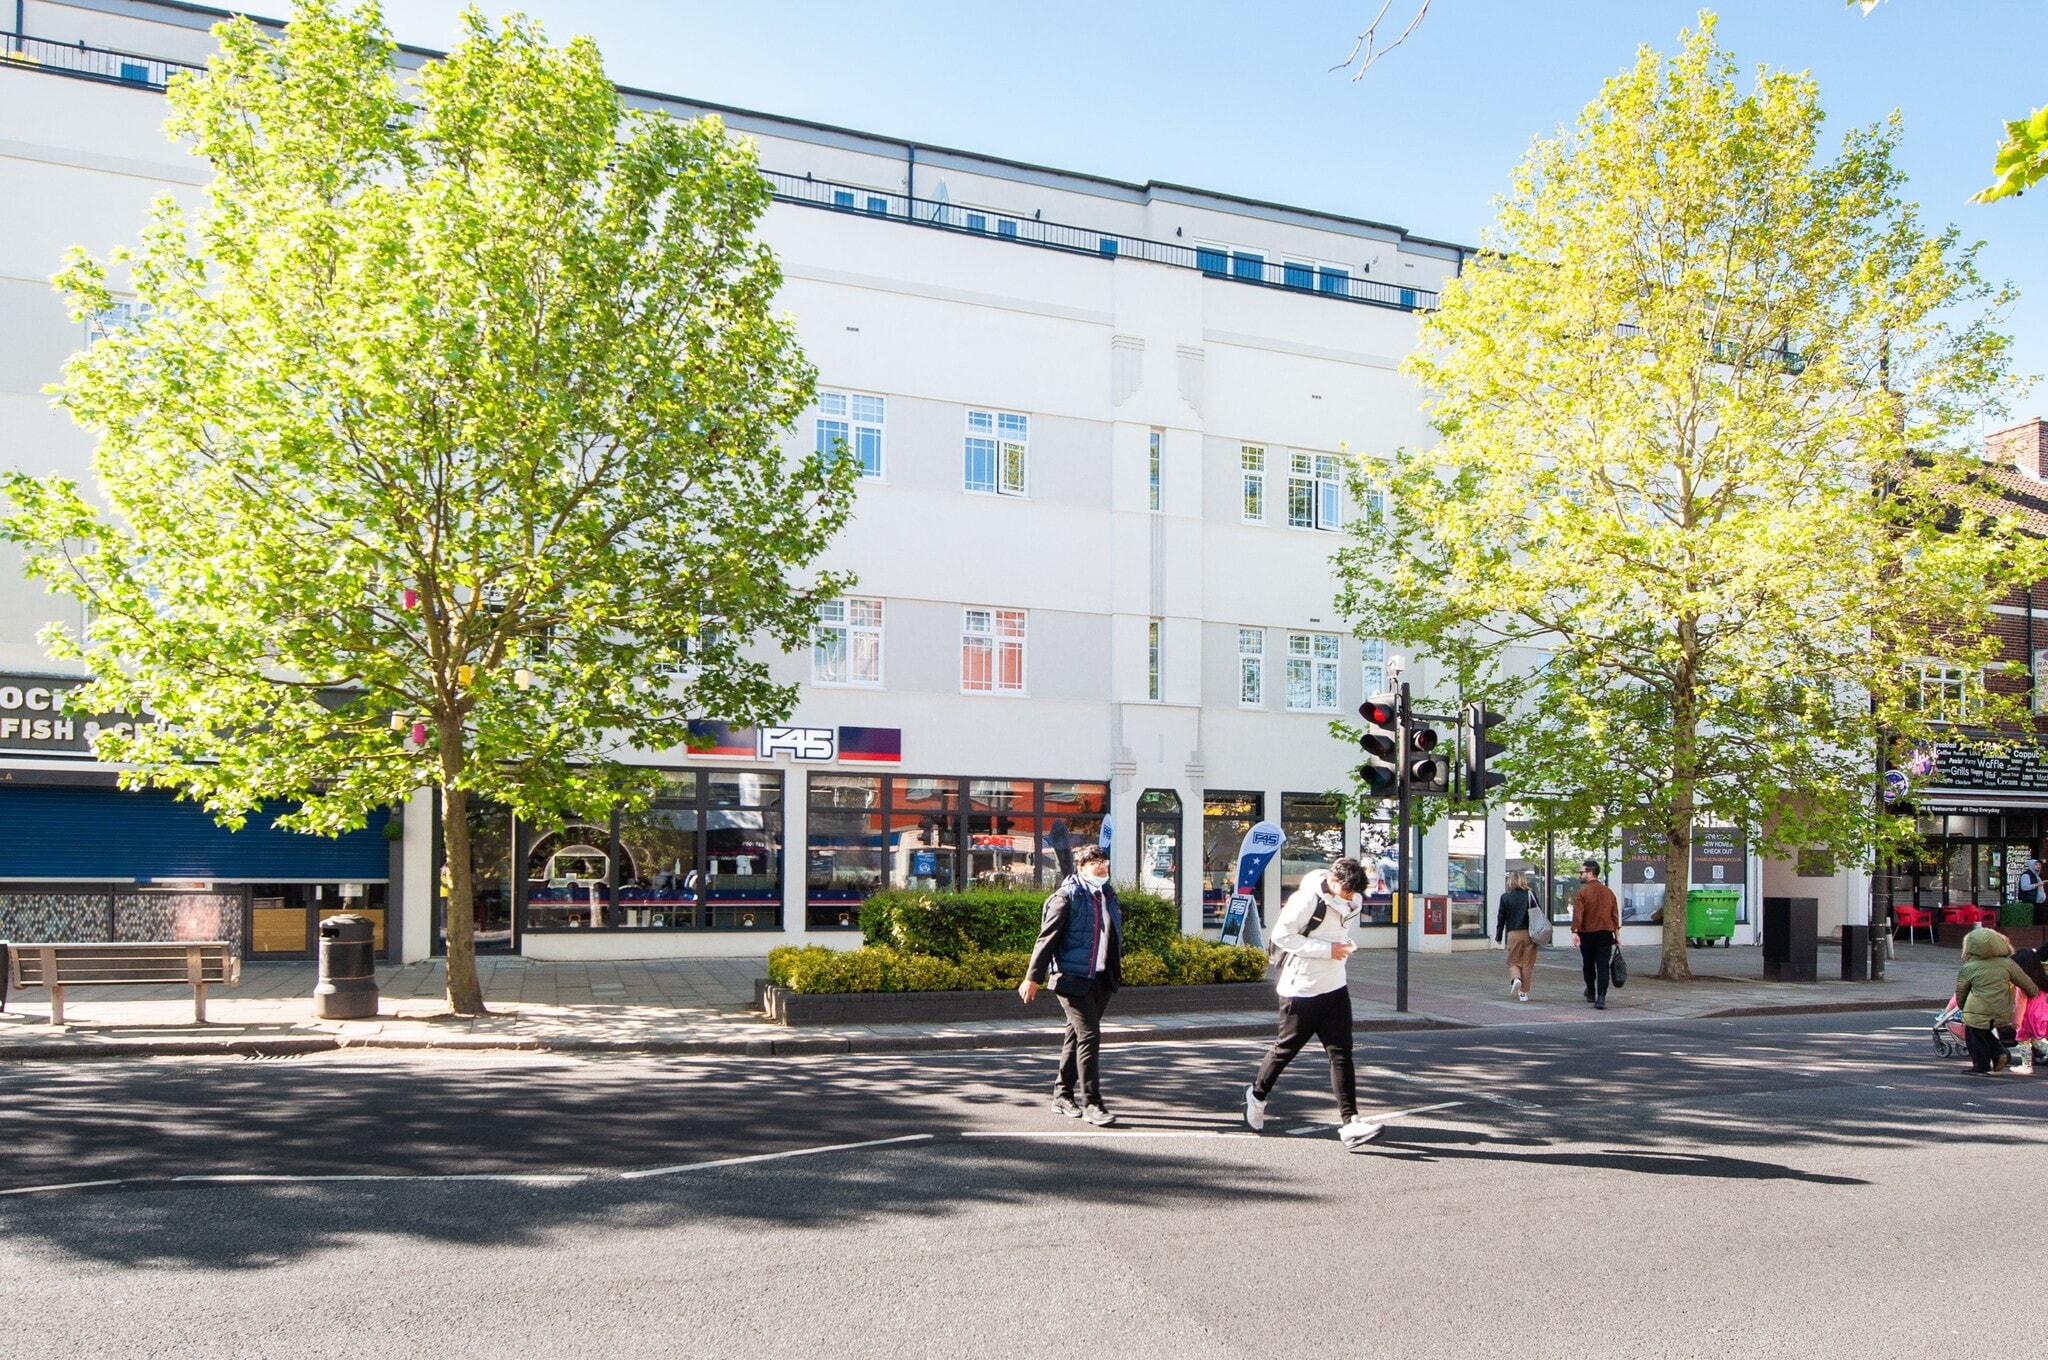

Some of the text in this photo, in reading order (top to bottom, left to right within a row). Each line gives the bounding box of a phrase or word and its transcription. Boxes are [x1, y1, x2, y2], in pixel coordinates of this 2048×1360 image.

[1, 718, 74, 740] FISH
[83, 721, 101, 742] &
[761, 726, 834, 760] F45
[1951, 767, 1970, 776] Grills
[1977, 759, 2004, 770] Waffle
[1252, 831, 1280, 847] F45
